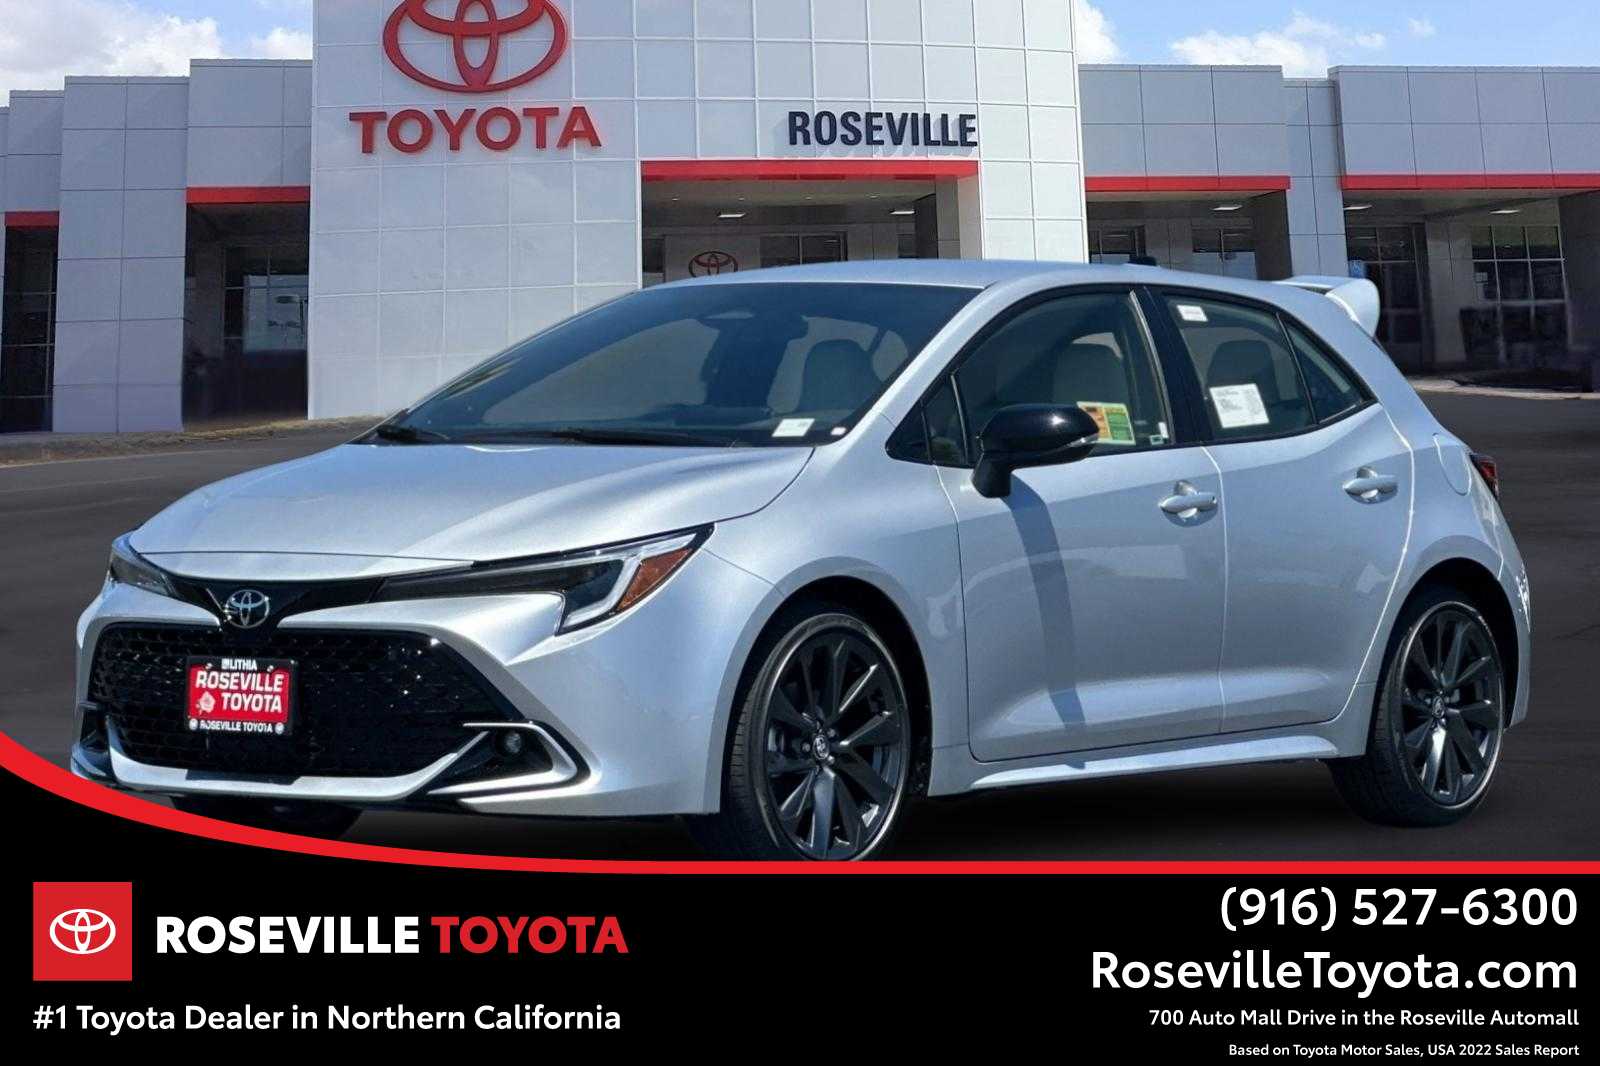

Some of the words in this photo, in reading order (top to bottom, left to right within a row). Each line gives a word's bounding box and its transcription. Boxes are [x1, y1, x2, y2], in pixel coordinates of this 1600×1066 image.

[349, 105, 602, 154] TOYOTA
[788, 111, 978, 148] ROSEVILLE
[195, 671, 284, 692] ROSEVILLE
[221, 692, 283, 713] TOYOTA
[199, 720, 242, 732] ROSEVILLE
[243, 721, 273, 733] TOYOTA
